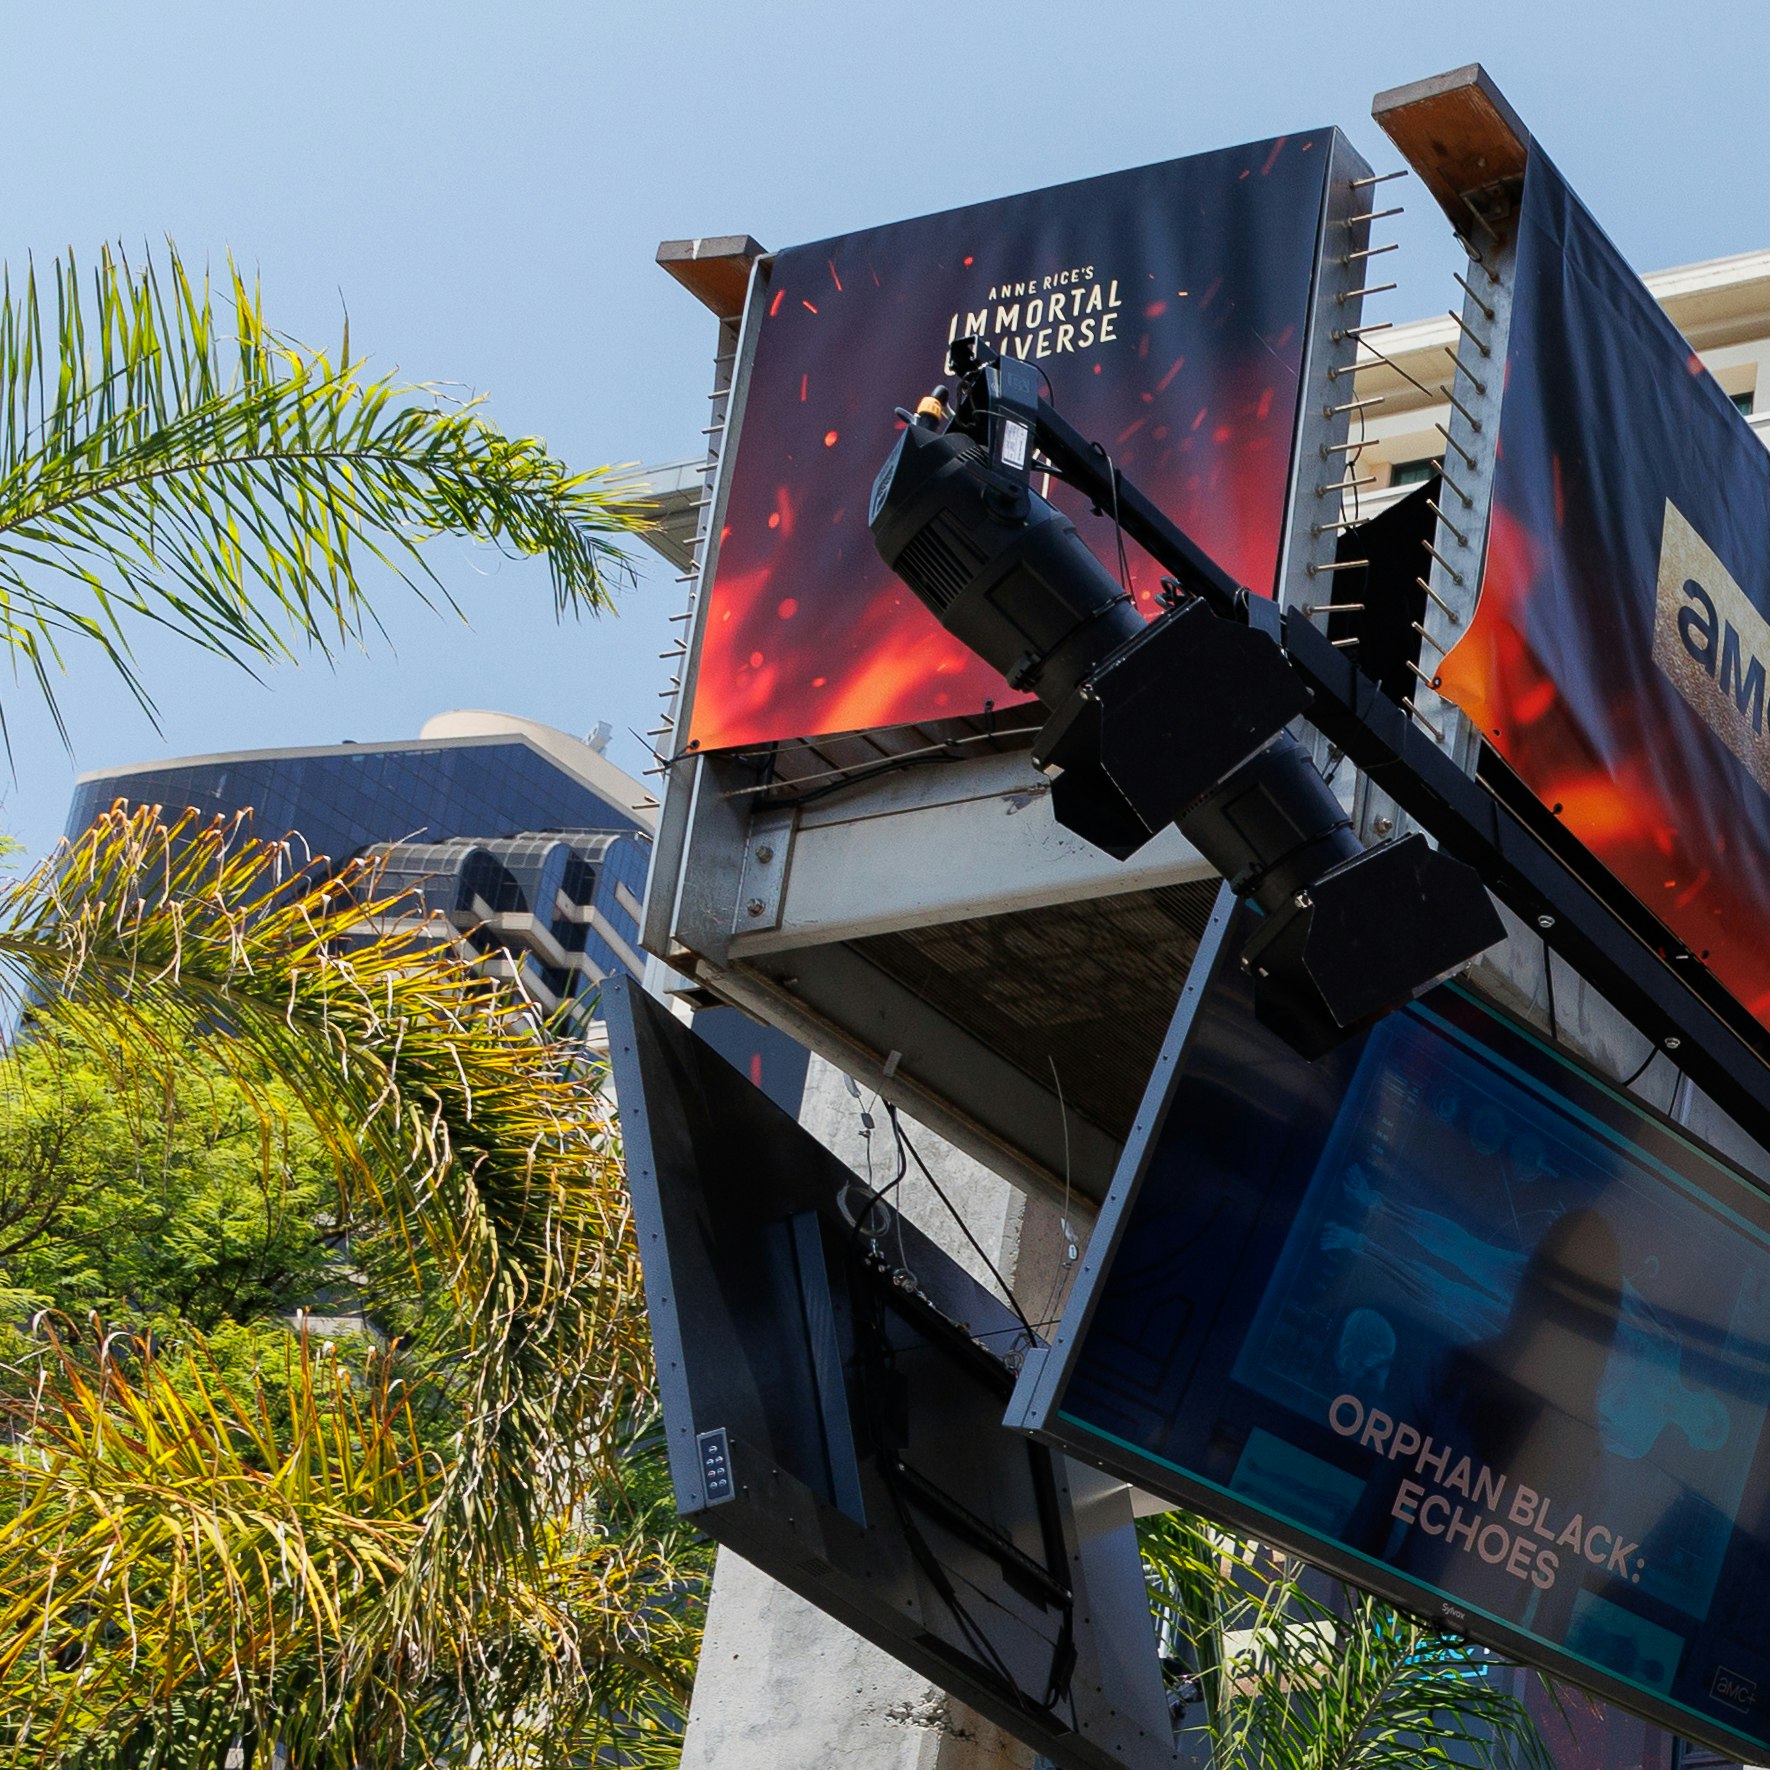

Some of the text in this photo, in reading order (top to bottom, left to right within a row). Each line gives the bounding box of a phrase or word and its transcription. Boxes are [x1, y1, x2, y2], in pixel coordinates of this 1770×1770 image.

[948, 279, 1122, 345] IMMORTAL
[989, 265, 1094, 300] ANNE RICE'S
[944, 312, 1118, 376] IVERSE
[1328, 1394, 1646, 1584] ORPHAN BLACK:
[1391, 1478, 1560, 1590] ECHOES
[1441, 1602, 1466, 1620] Sylvox
